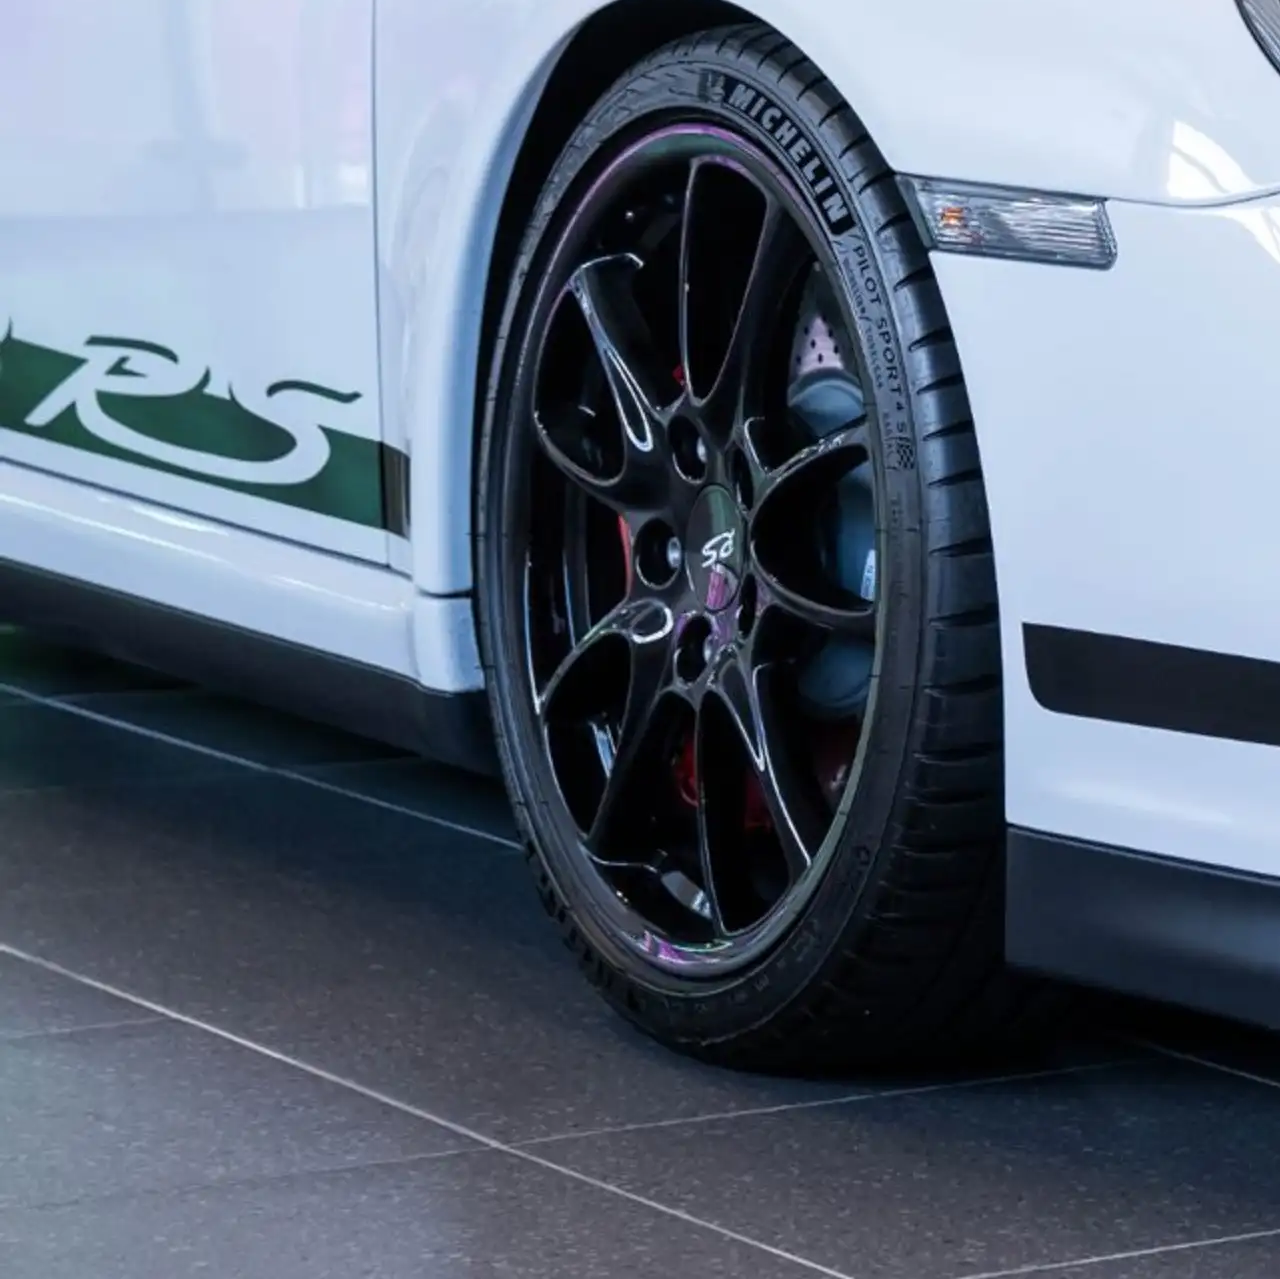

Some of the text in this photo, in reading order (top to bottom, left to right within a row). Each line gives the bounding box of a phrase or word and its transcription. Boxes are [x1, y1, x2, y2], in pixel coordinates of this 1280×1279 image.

[727, 83, 849, 224] MICHELIN
[852, 245, 882, 304] PILOT
[877, 317, 903, 396] SPORT
[23, 334, 363, 487] RS
